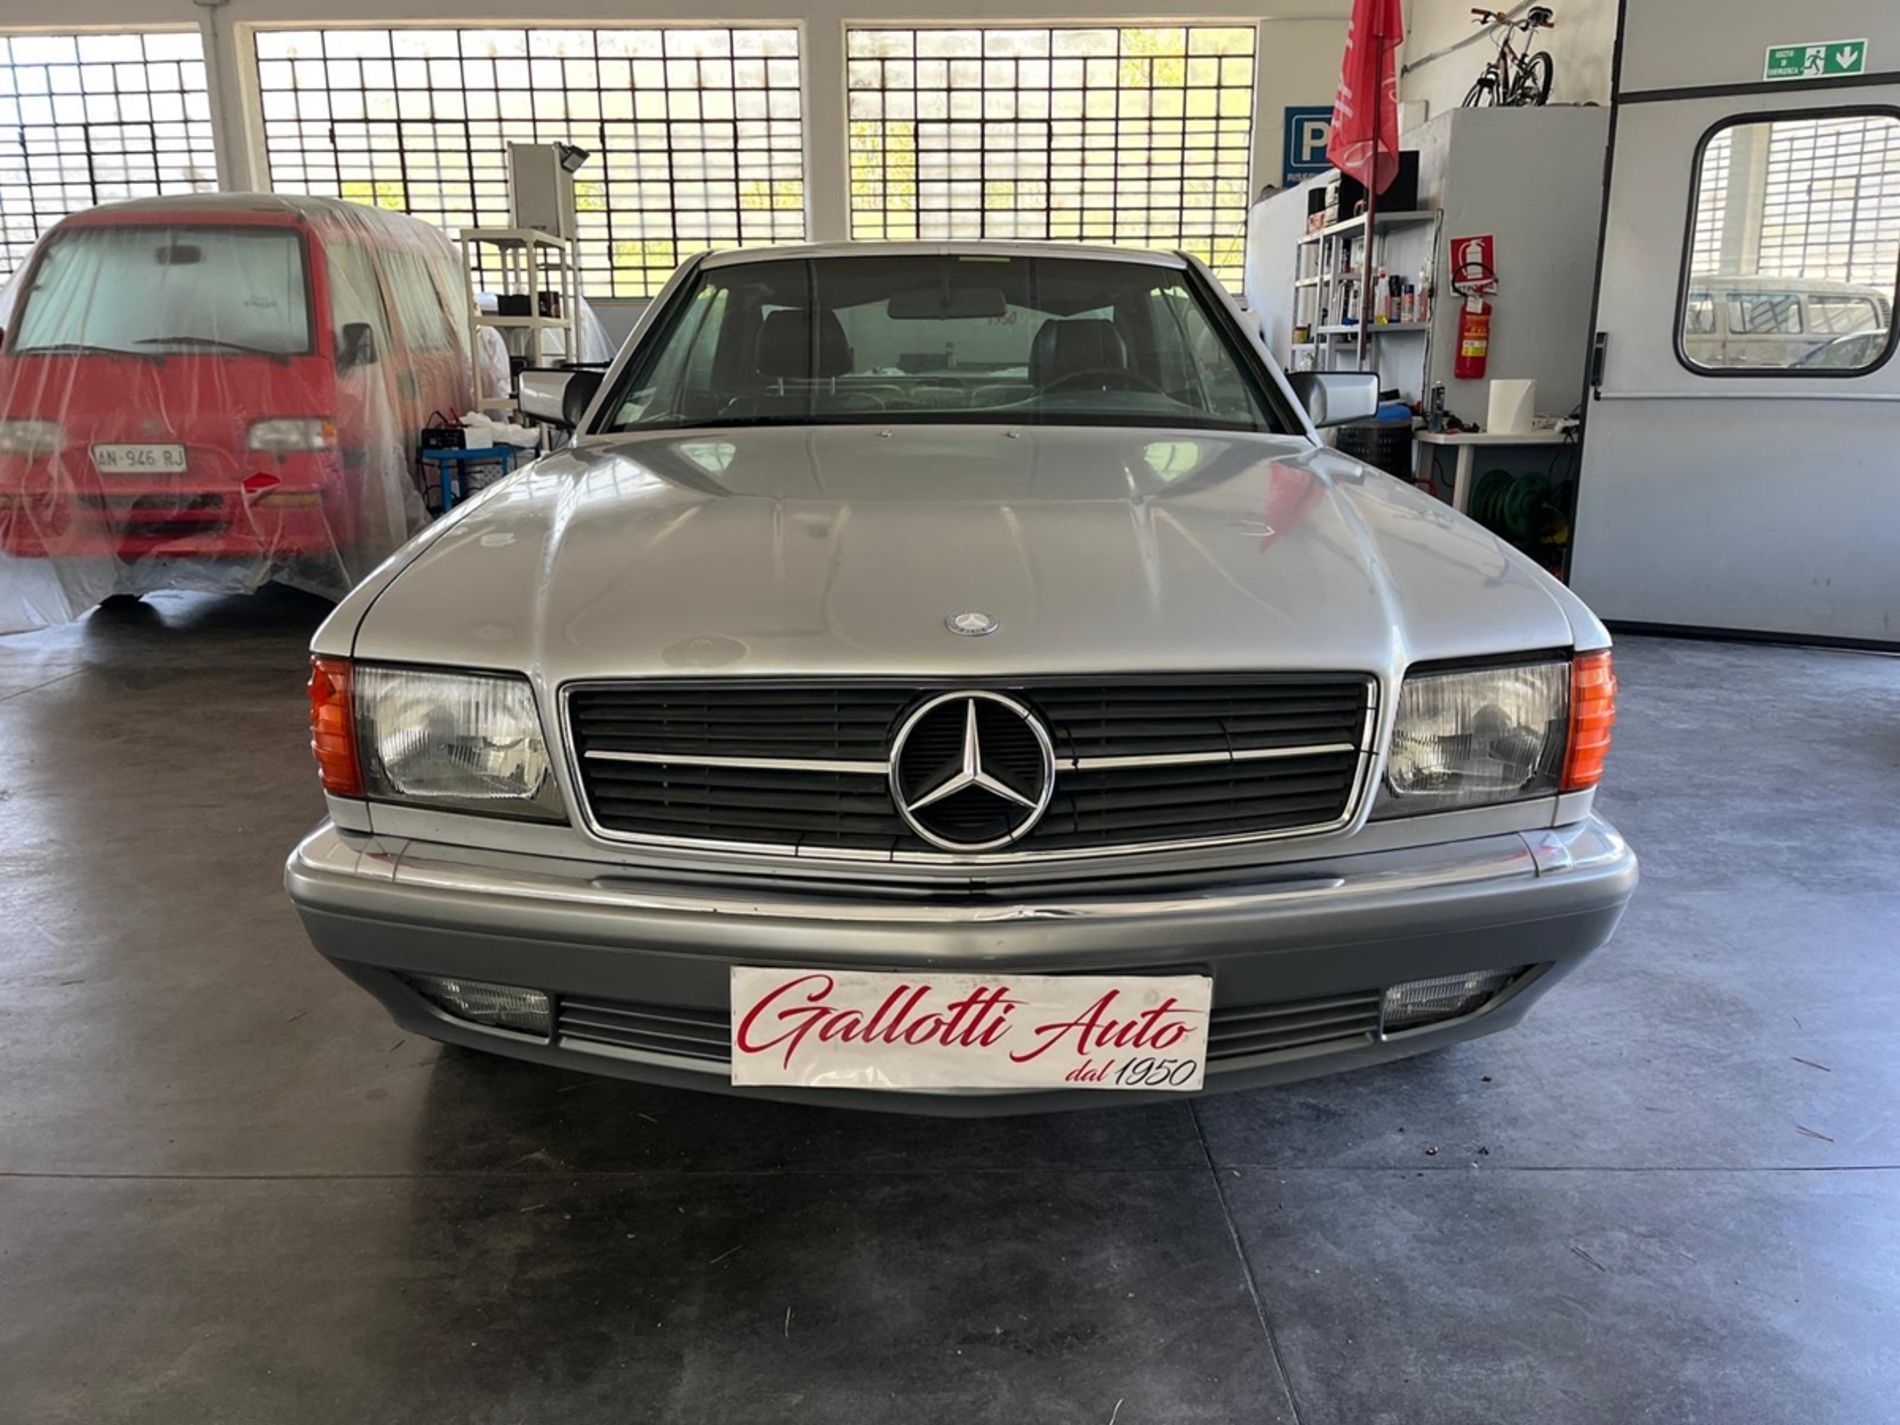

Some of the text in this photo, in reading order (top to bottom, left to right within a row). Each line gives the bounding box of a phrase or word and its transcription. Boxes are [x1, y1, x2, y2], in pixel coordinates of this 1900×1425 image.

[737, 974, 1204, 1070] Gallotti Auto
[1064, 1057, 1197, 1086] dal 1950
